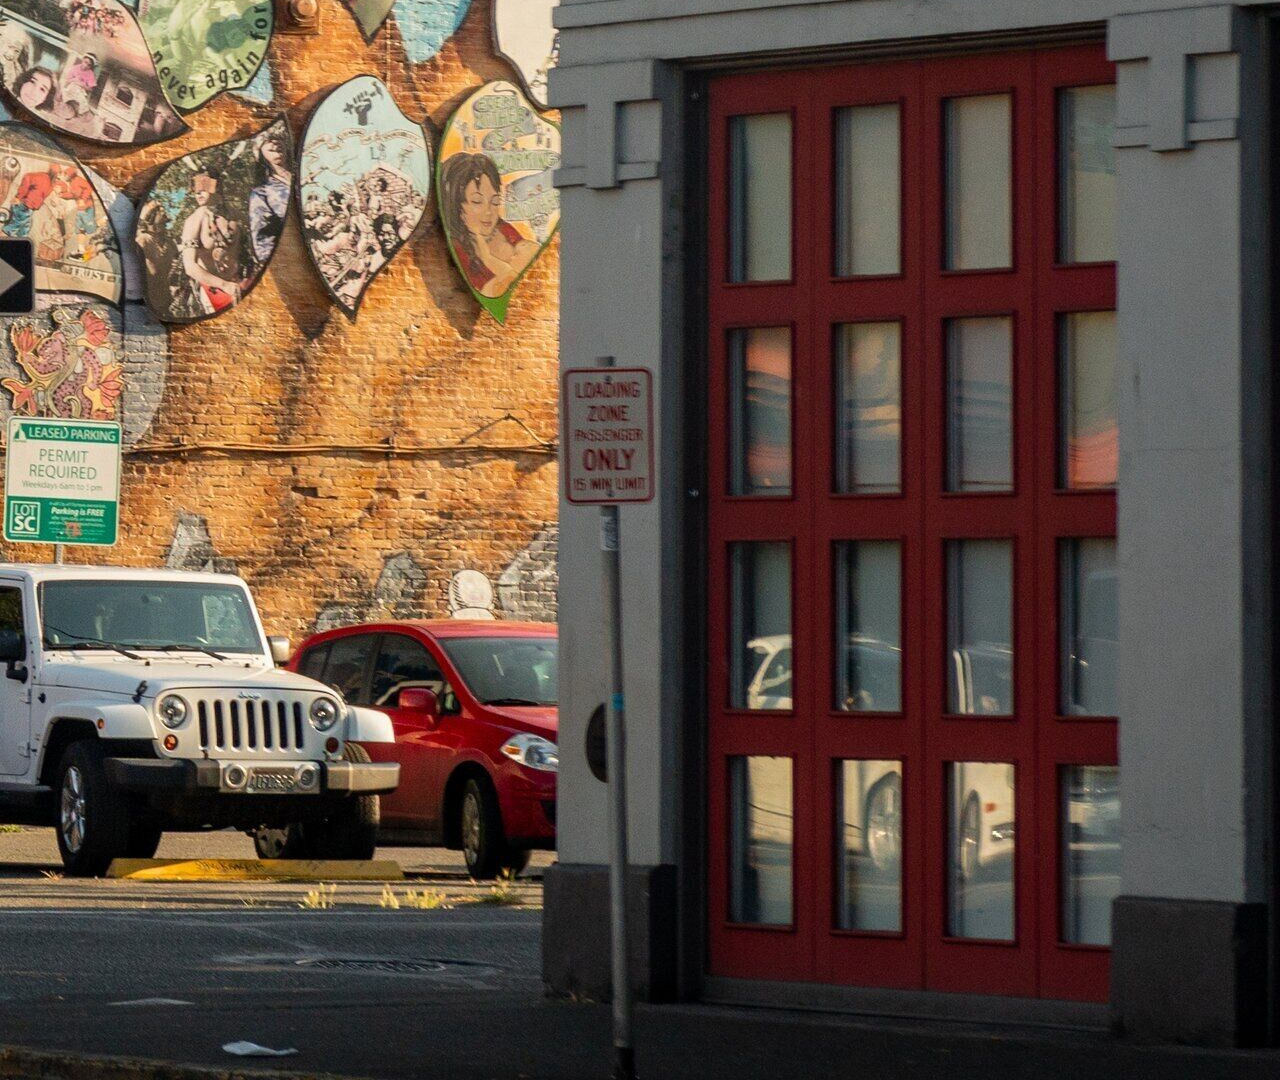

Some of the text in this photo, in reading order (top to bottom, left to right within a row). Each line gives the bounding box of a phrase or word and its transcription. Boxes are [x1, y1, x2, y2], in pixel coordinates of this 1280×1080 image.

[153, 50, 197, 100] never
[205, 50, 260, 89] again
[249, 6, 268, 40] for
[575, 382, 640, 398] LOADING
[588, 405, 630, 422] ZONE
[28, 426, 116, 442] LEASED PARKING
[575, 429, 643, 442] PASSENGER
[39, 448, 89, 463] PERMIT
[583, 448, 636, 471] ONLY
[29, 464, 97, 480] REQUIRED
[22, 480, 58, 490] Weekdays
[14, 504, 36, 516] LOT
[51, 506, 79, 517] Parking
[86, 508, 105, 517] FREE
[13, 516, 36, 531] SC
